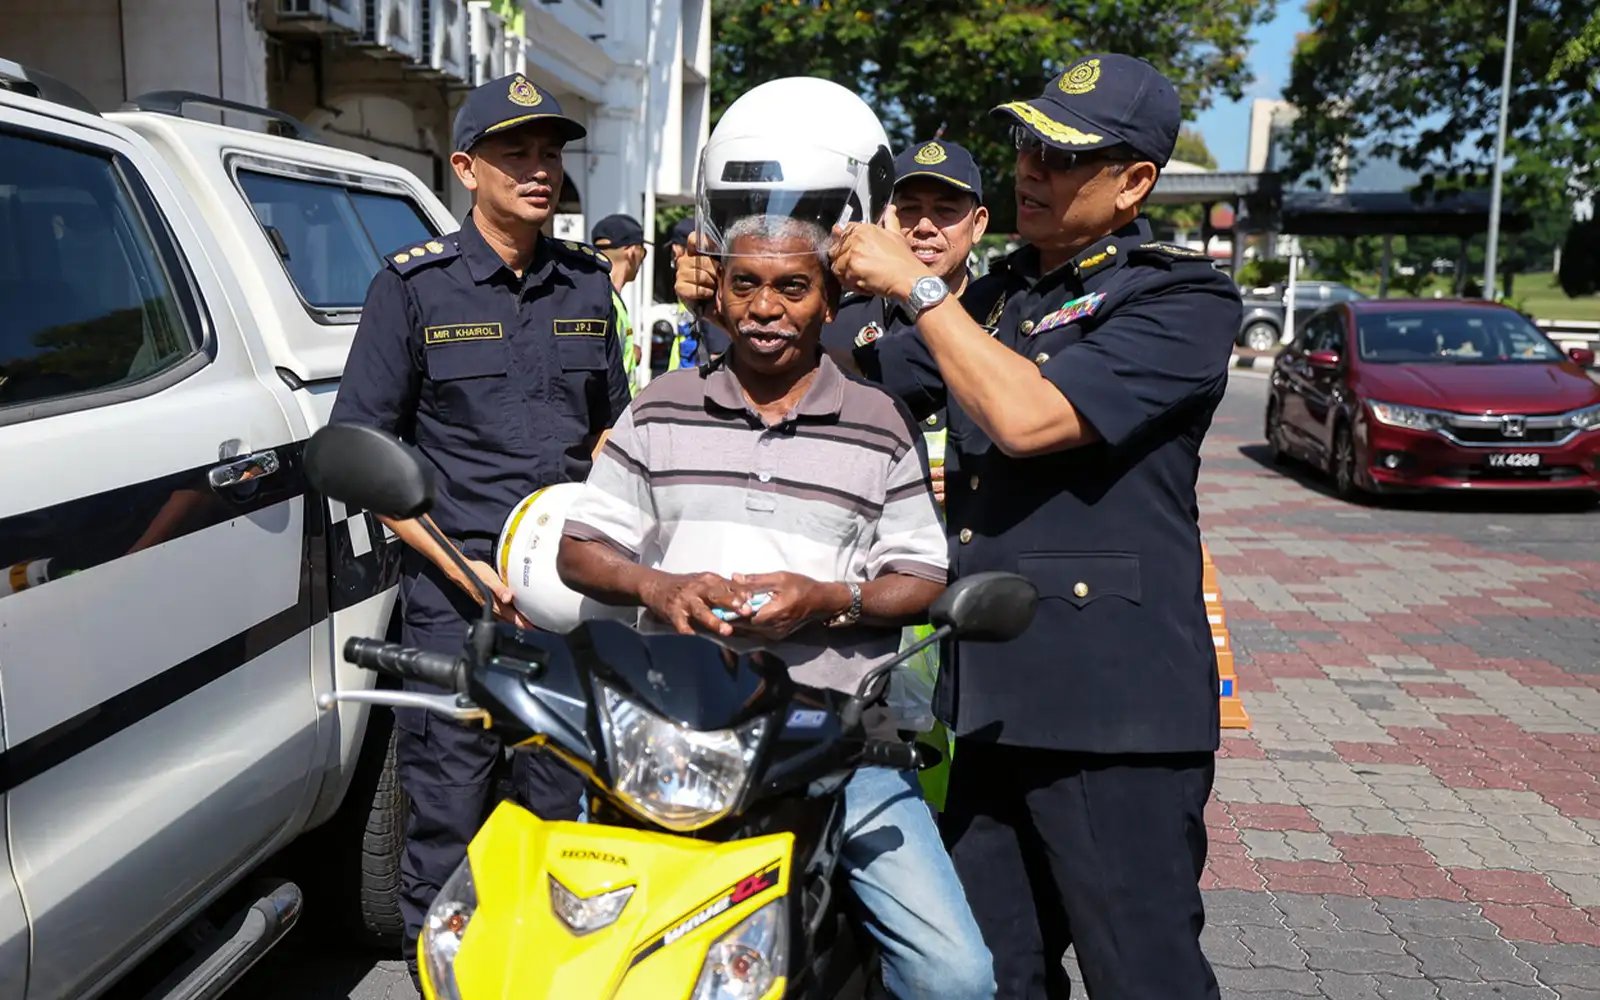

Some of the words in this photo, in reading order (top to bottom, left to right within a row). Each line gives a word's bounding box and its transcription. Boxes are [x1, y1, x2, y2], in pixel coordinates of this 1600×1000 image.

[433, 329, 450, 339] MIR
[455, 327, 496, 338] KHAIROL
[574, 322, 592, 332] JPJ
[560, 849, 629, 866] HONDA
